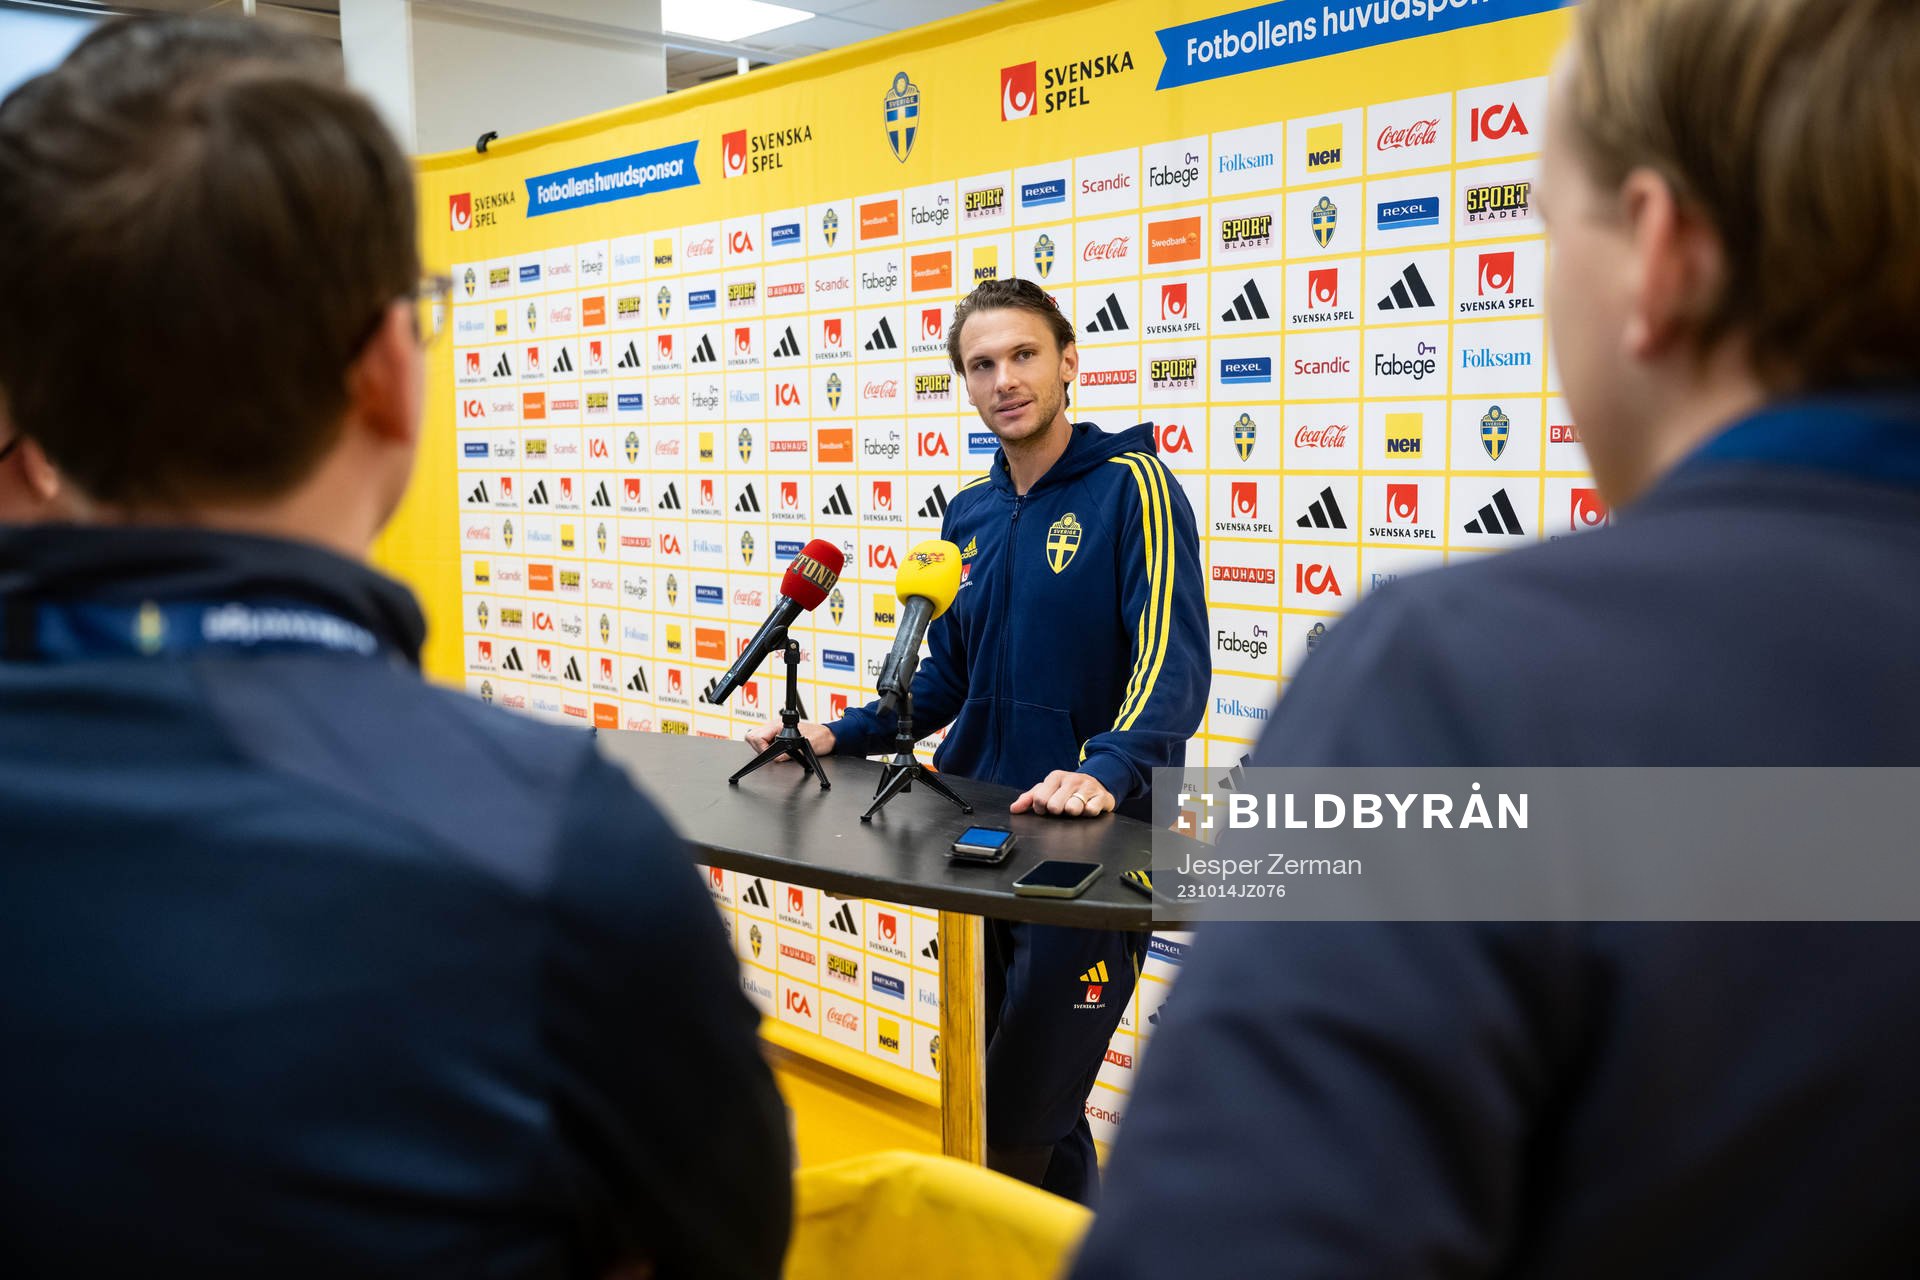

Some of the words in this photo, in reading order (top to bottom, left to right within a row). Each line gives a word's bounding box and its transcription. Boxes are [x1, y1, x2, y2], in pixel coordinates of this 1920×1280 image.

[1187, 16, 1317, 66] Fotbollens
[1044, 51, 1135, 90] SVENSKA
[1045, 86, 1090, 114] SPEL
[1470, 102, 1529, 142] ICA
[751, 125, 813, 153] SVENSKA
[752, 152, 783, 174] SPEL
[1217, 152, 1275, 174] Folksam
[537, 178, 595, 205] Fotbollens
[595, 159, 684, 192] huvudsponsor
[1081, 172, 1132, 195] Scandic
[1149, 165, 1200, 188] Fabege
[474, 191, 516, 212] SVENSKA
[965, 187, 1004, 213] SPORT
[1466, 182, 1531, 213] SPORT
[475, 211, 498, 228] SPEL
[911, 206, 950, 226] Fabege
[967, 207, 1003, 219] BLADET
[1469, 208, 1529, 222] BLADET
[1222, 214, 1273, 242] SPORT
[729, 231, 754, 256] ICA
[1151, 235, 1187, 249] Swedbank
[1224, 238, 1271, 250] BLADET
[728, 283, 757, 301] SPORT
[768, 283, 805, 298] BAUHAUS
[815, 278, 850, 293] Scandic
[862, 272, 898, 292] Fabege
[1460, 299, 1506, 313] SVENSKA
[1508, 298, 1536, 310] SPEL
[1292, 312, 1332, 324] SVENSKA
[1333, 310, 1355, 321] SPEL
[1146, 324, 1183, 335] SVENSKA
[1183, 322, 1201, 332] SPEL
[911, 345, 935, 354] SVENSKA
[1462, 348, 1532, 369] Folksam
[1151, 358, 1197, 381] SPORT
[1294, 356, 1351, 375] Scandic
[1375, 353, 1436, 381] Fabege
[915, 374, 952, 393] SPORT
[1080, 369, 1137, 387] BAUHAUS
[1153, 379, 1196, 389] BLADET
[775, 383, 801, 407] ICA
[464, 400, 486, 418] ICA
[590, 438, 609, 459] ICA
[770, 440, 808, 453] BAUHAUS
[864, 439, 901, 460] Fabege
[918, 432, 950, 457] ICA
[863, 514, 888, 522] SVENSKA
[889, 514, 902, 523] SPEL
[1215, 522, 1251, 532] SVENSKA
[1253, 523, 1273, 533] SPEL
[1369, 527, 1411, 538] SVENSKA
[1413, 528, 1437, 539] SPEL
[660, 533, 681, 555] ICA
[868, 544, 898, 569] ICA
[1213, 566, 1276, 584] BAUHAUS
[1296, 563, 1342, 596] ICA
[532, 612, 554, 632] ICA
[736, 637, 750, 658] IC
[1218, 631, 1268, 660] Fabege
[867, 659, 883, 677] Fab
[1216, 698, 1269, 720] Folksam
[1183, 783, 1198, 792] PEL
[869, 941, 894, 954] SVENSKA
[895, 947, 907, 958] SPEL
[827, 953, 858, 979] SPORT
[786, 988, 812, 1018] ICA
[919, 988, 938, 1006] Folk
[1085, 1101, 1121, 1125] Scandi
